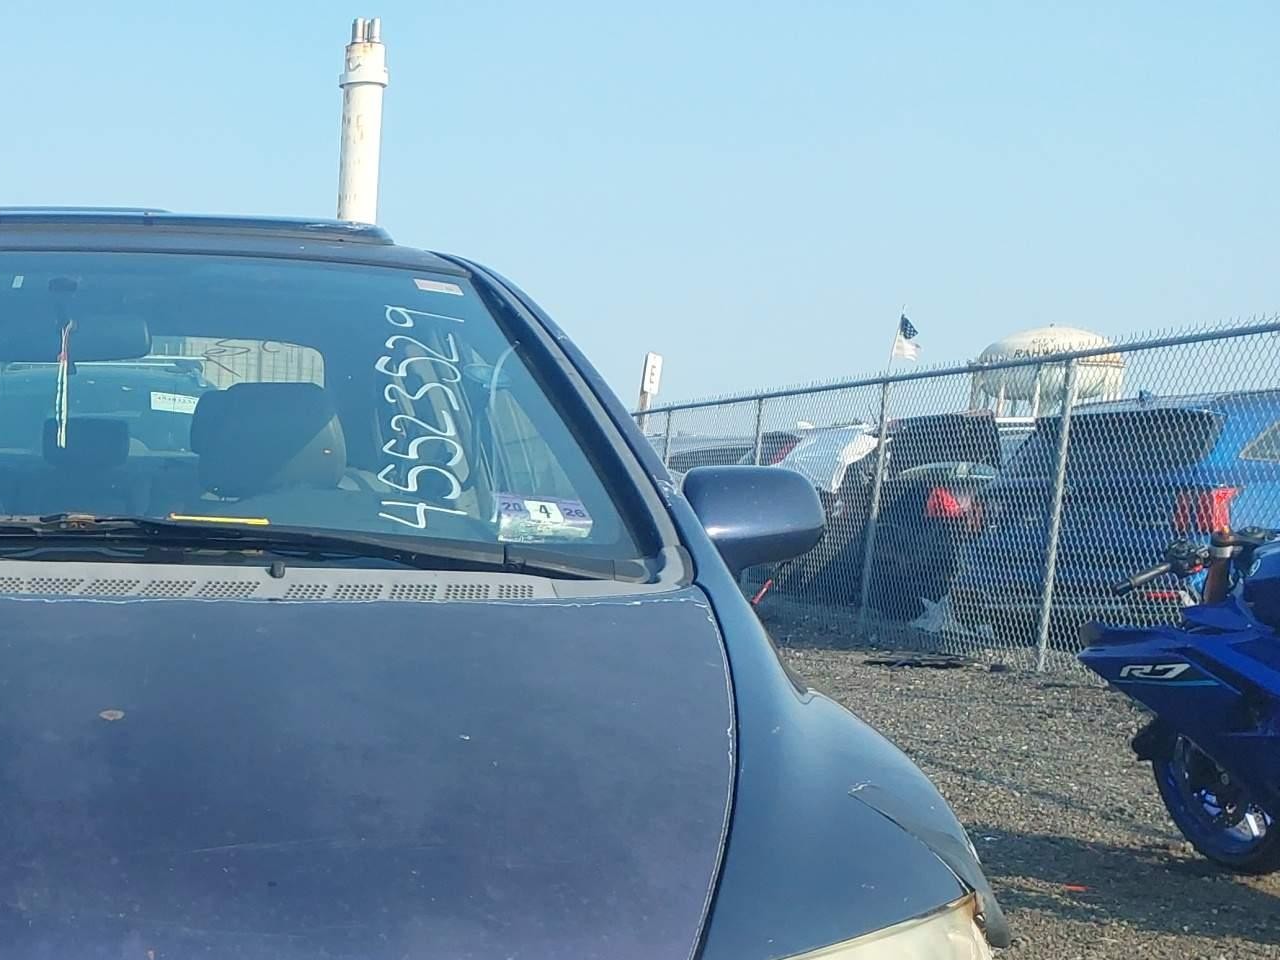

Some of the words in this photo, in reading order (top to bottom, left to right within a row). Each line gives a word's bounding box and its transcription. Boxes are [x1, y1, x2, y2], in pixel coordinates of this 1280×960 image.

[375, 304, 467, 529] 45523529
[501, 502, 523, 512] 20
[539, 504, 553, 519] 4
[563, 507, 587, 518] 26
[1120, 663, 1191, 679] R7
